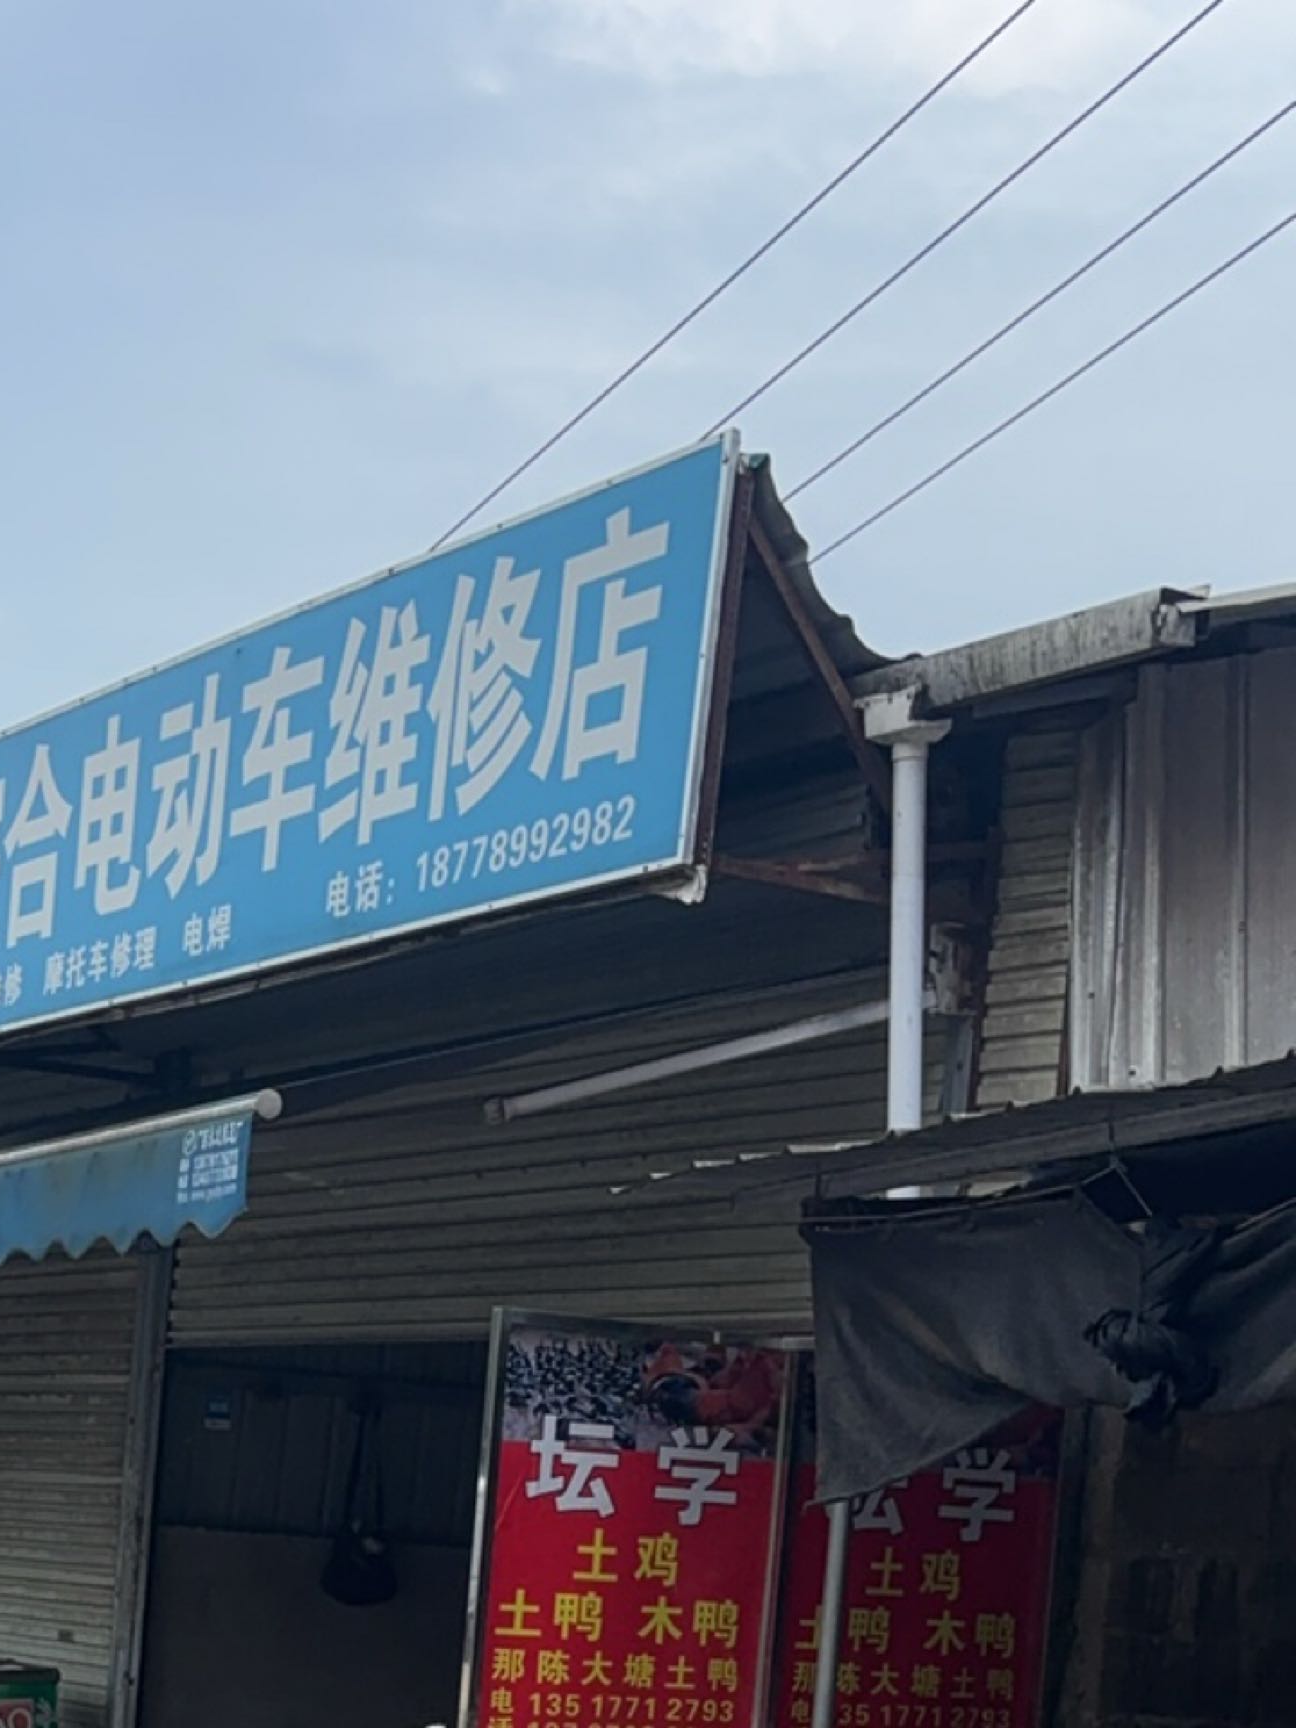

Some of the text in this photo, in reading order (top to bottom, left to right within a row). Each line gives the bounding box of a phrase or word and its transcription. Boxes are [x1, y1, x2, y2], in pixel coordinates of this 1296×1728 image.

[42, 925, 157, 995] 摩托车修理
[182, 904, 232, 957] 电焊
[415, 794, 636, 893] 18778992982
[525, 1415, 740, 1526] 坛学
[573, 1528, 680, 1588] 土鸡
[865, 1548, 962, 1602] 土鸡
[494, 1588, 740, 1649] 土鸭 木鸭
[922, 1608, 1017, 1659] 木鸭
[491, 1647, 739, 1693] 那陈大塘土鸭
[529, 1692, 735, 1723] 135 1771 2793
[879, 1704, 943, 1728] 1771
